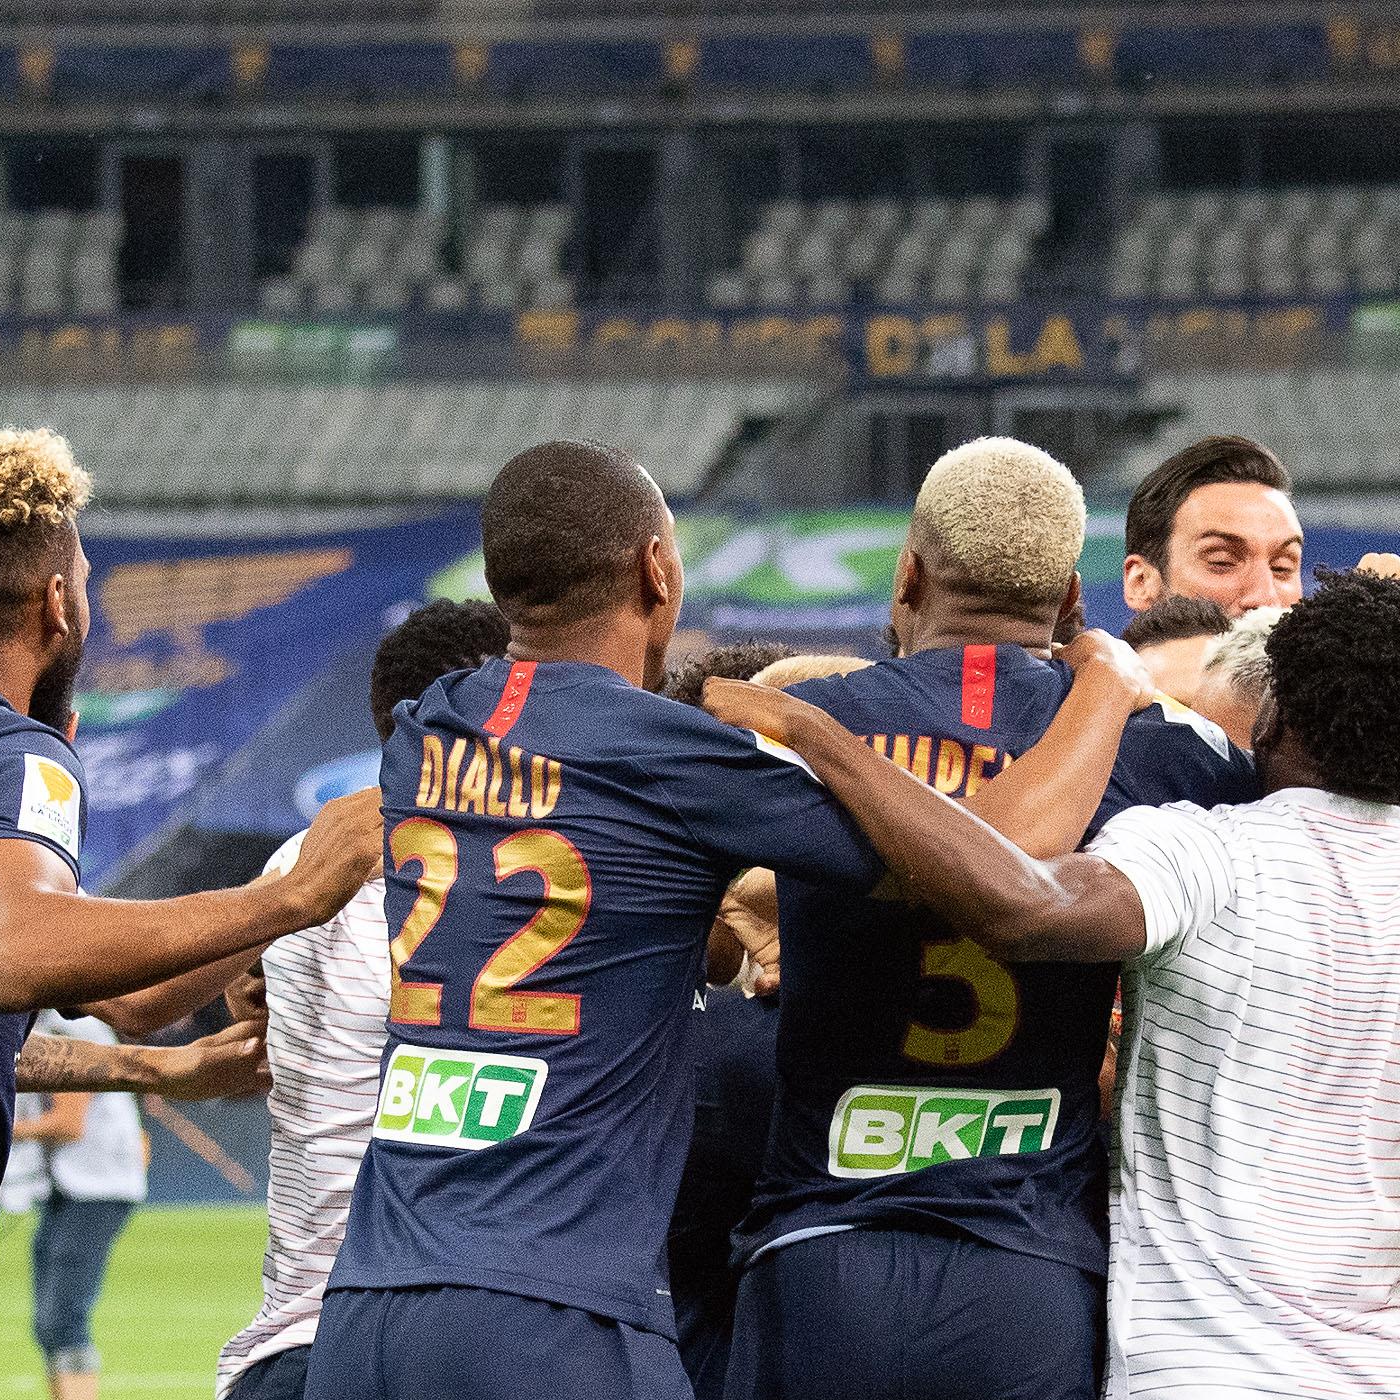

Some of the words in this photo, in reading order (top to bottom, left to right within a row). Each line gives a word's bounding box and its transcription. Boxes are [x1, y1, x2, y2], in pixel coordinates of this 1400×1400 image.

[415, 734, 562, 820] DIALLO
[389, 816, 593, 1036] 22
[381, 1060, 534, 1136] BKT
[838, 1103, 1050, 1164] BKT
